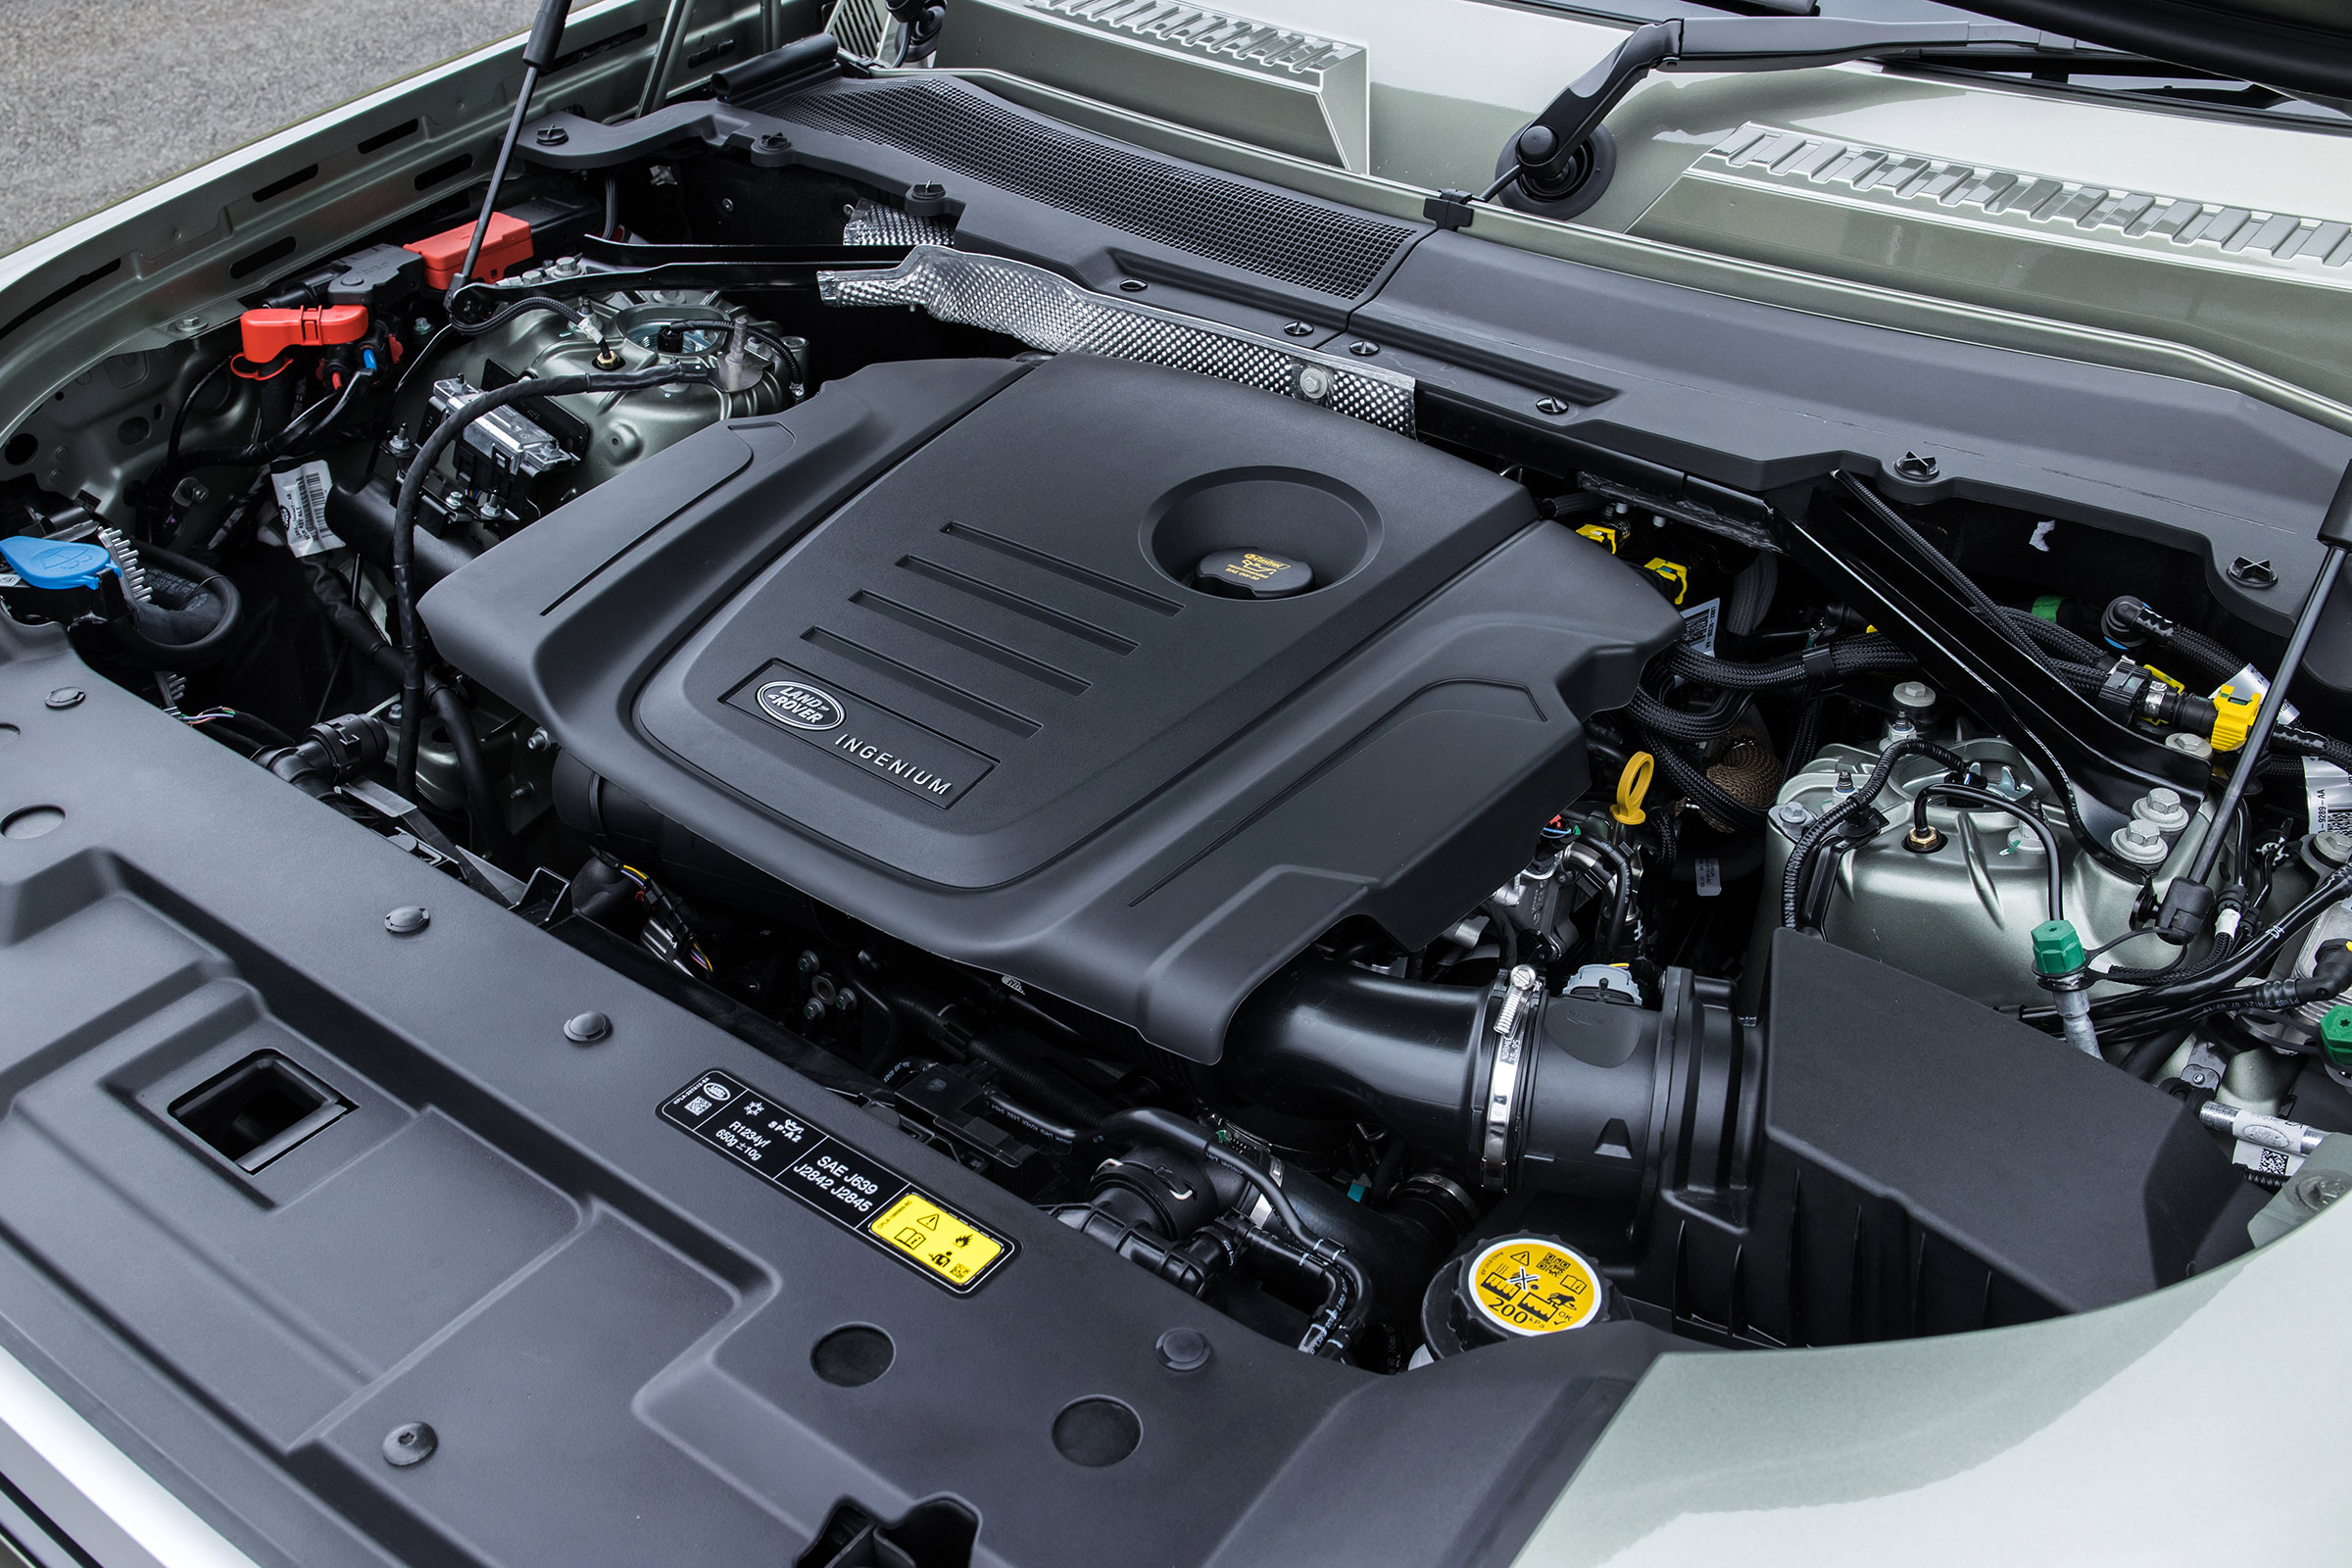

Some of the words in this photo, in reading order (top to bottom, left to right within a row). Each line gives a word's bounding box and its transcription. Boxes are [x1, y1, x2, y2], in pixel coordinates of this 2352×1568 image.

[772, 697, 824, 724] ROVER
[779, 686, 822, 710] LAND
[834, 733, 953, 796] INGENIUM
[715, 1128, 739, 1147] 650g
[728, 1120, 772, 1148] R1234yf
[793, 1163, 835, 1190] J2842
[830, 1186, 873, 1212] J2845
[816, 1155, 850, 1177] SAE
[844, 1173, 879, 1195] J639
[1488, 1297, 1529, 1324] 200
[1528, 1317, 1545, 1329] kPa
[1558, 1310, 1574, 1322] OK
